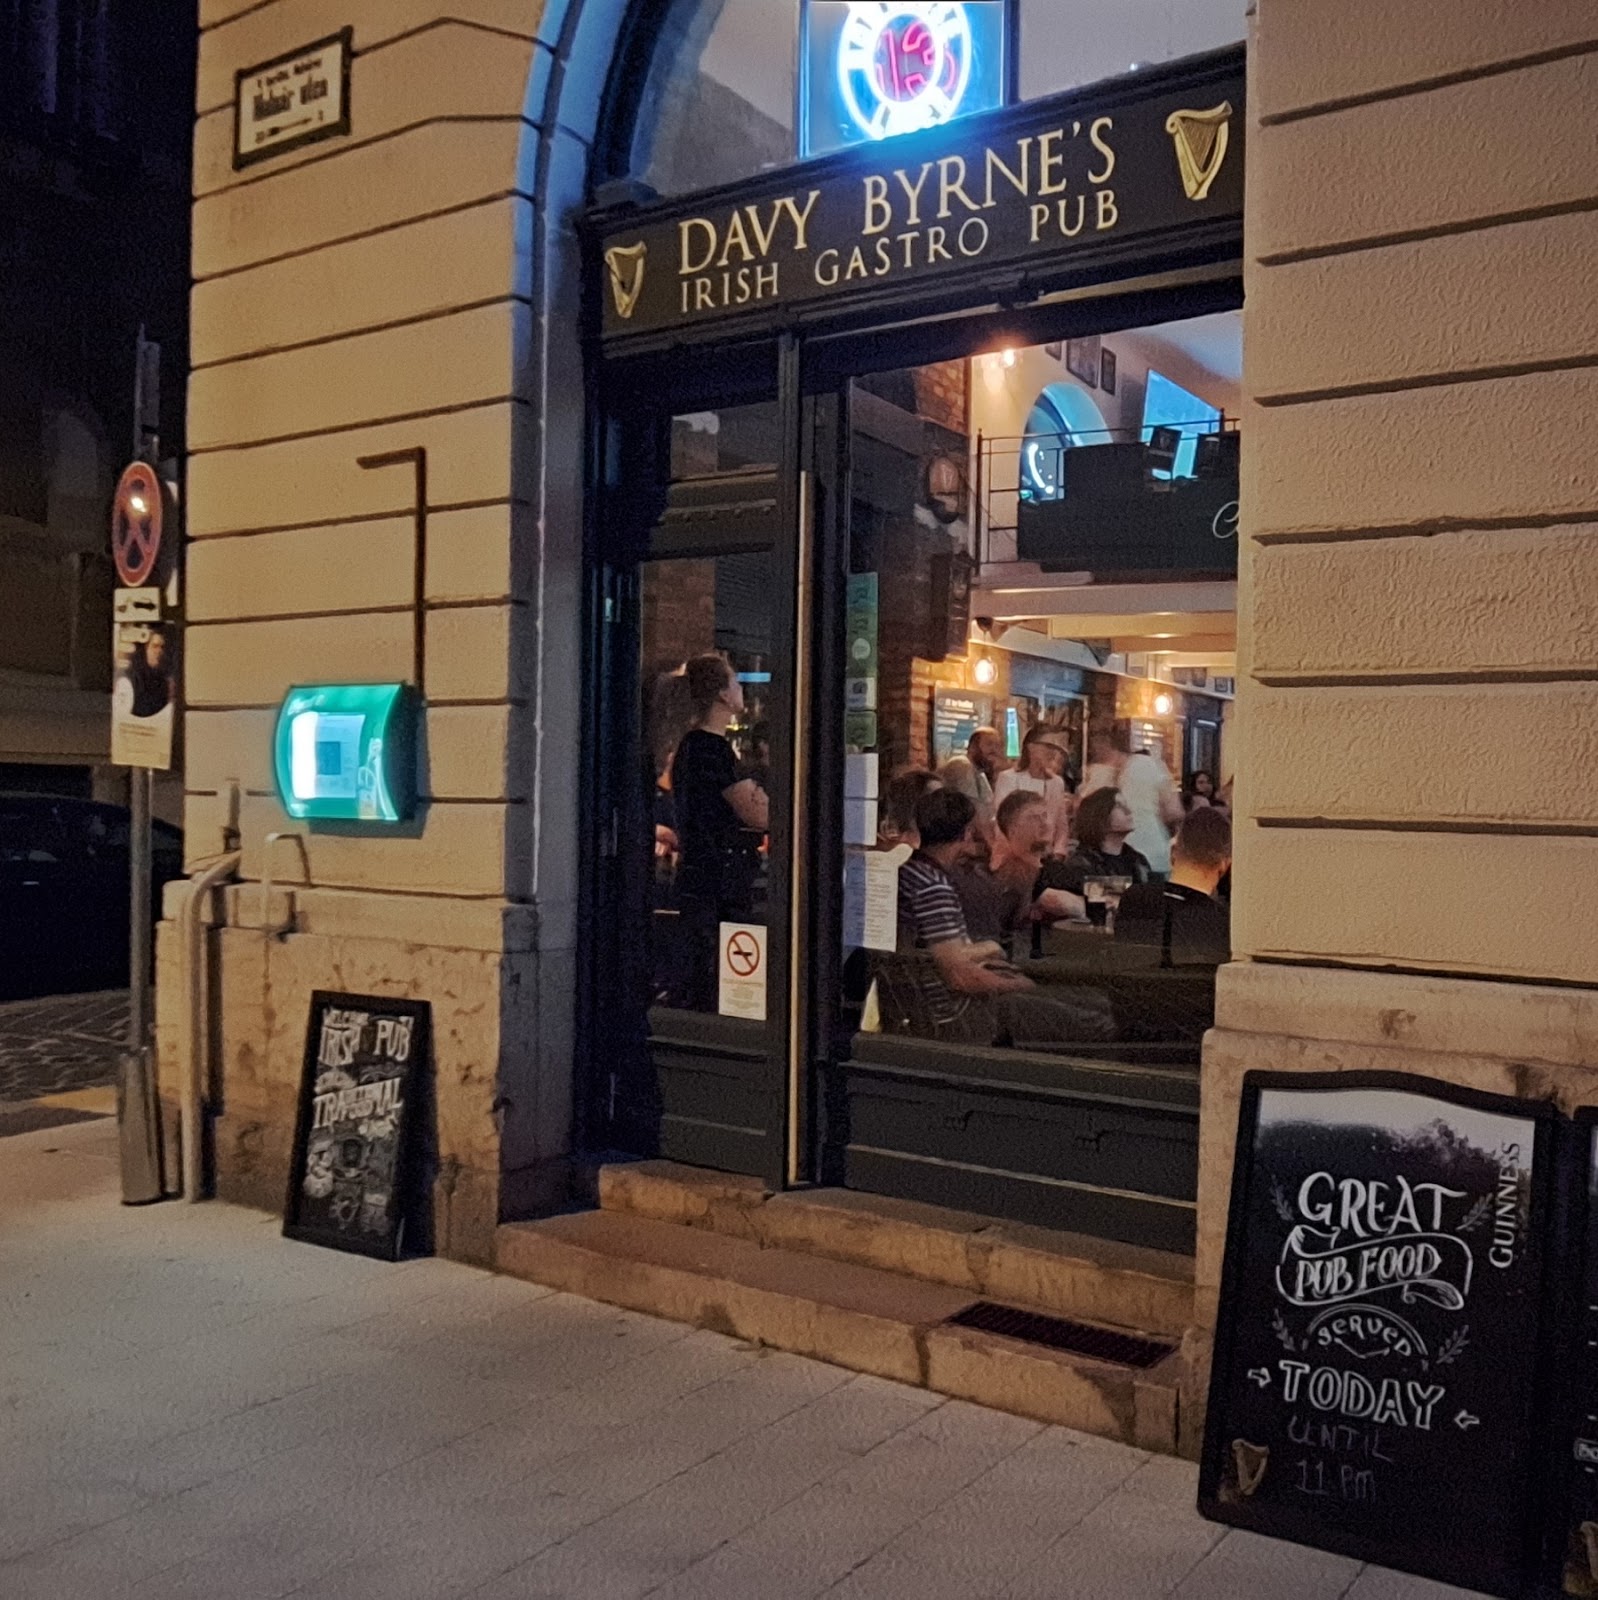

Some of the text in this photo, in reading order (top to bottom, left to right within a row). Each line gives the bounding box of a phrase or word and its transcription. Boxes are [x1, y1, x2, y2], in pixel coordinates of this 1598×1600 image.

[679, 117, 1116, 275] DAVY BYRNE'S
[681, 190, 1118, 312] IRISH GASTRO PUB
[374, 1019, 410, 1062] PUB
[1300, 1172, 1466, 1236] GREAT
[1490, 1142, 1520, 1268] GUINNESS
[1296, 1242, 1442, 1298] PUB FOOD
[1279, 1360, 1445, 1429] TODAY
[1288, 1415, 1393, 1463] UNTIL
[1295, 1460, 1329, 1495] 11
